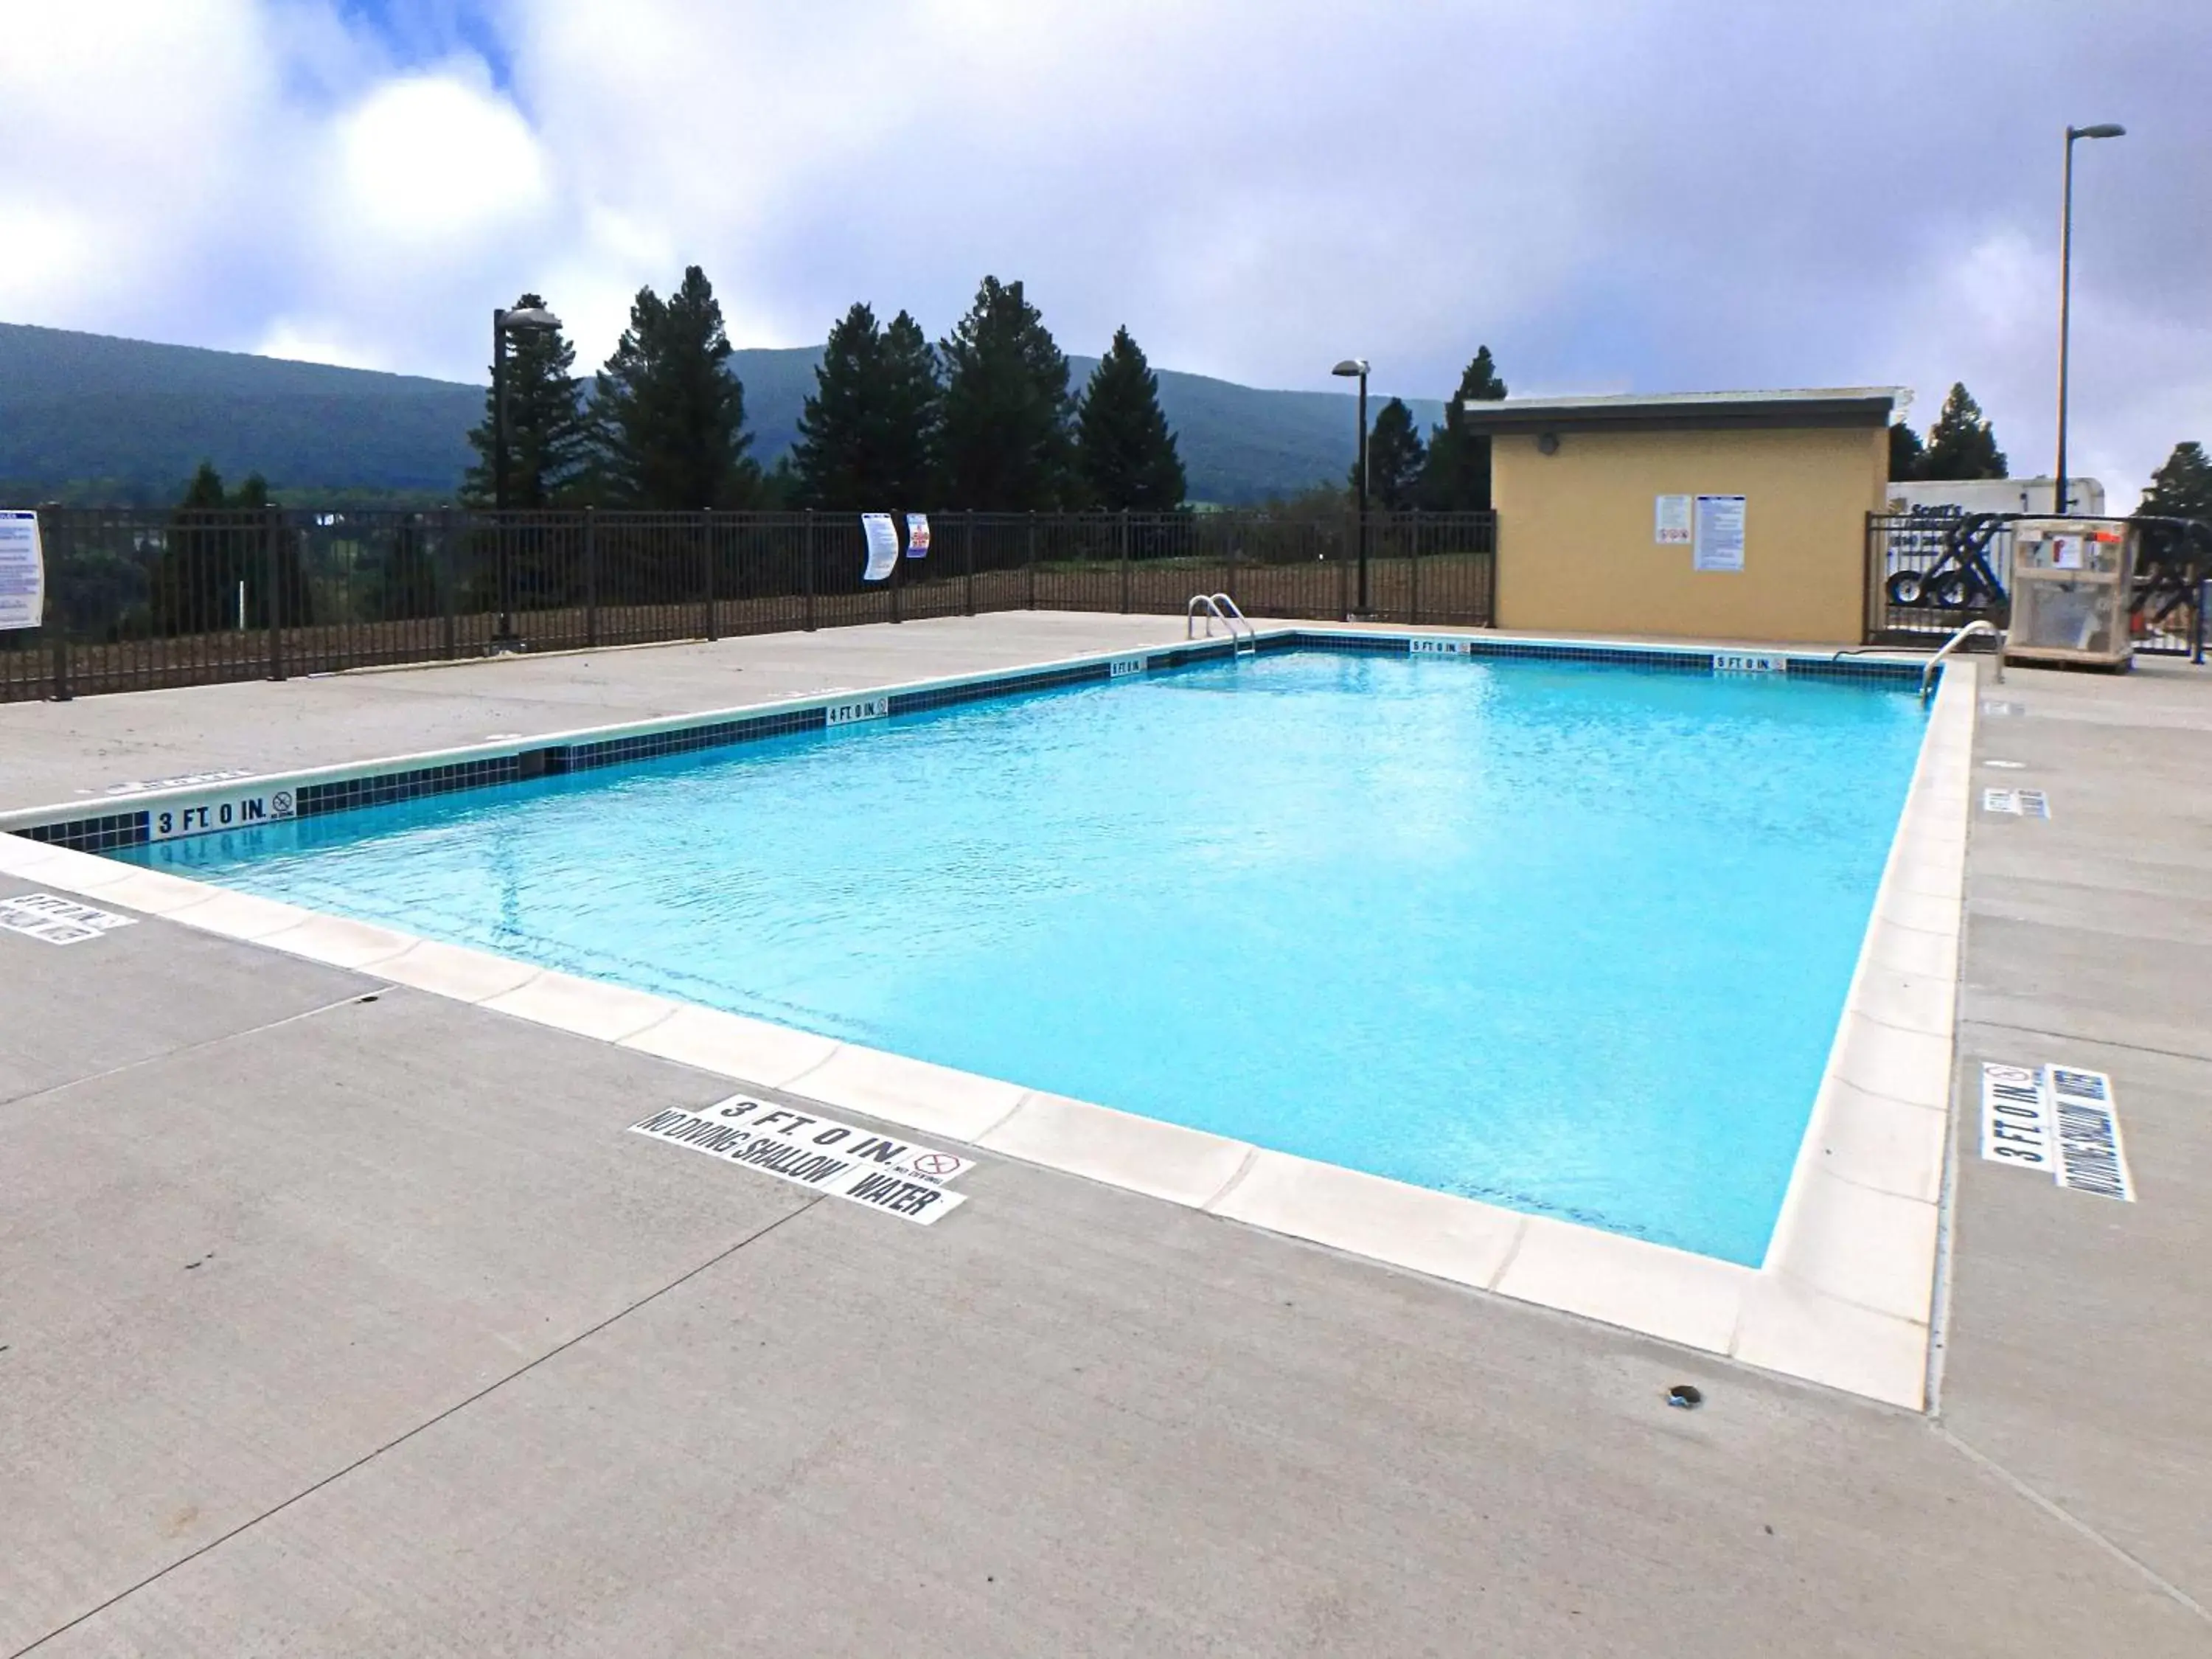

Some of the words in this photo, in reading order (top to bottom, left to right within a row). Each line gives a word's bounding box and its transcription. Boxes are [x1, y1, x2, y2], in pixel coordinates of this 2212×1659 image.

[830, 709, 836, 722] 4
[855, 704, 863, 718] 0
[159, 813, 173, 834] 3
[184, 807, 209, 831] FT.
[220, 803, 232, 824] 0
[241, 798, 266, 821] IN.
[720, 1102, 759, 1118] 3
[751, 1110, 817, 1136] FT.
[812, 1127, 852, 1145] 0
[846, 1138, 908, 1165] IN.
[636, 1110, 687, 1133] NO
[662, 1117, 751, 1152] DIVING
[731, 1138, 849, 1183] SHALLOW
[845, 1172, 942, 1215] WATER
[1993, 1146, 2044, 1163] 3
